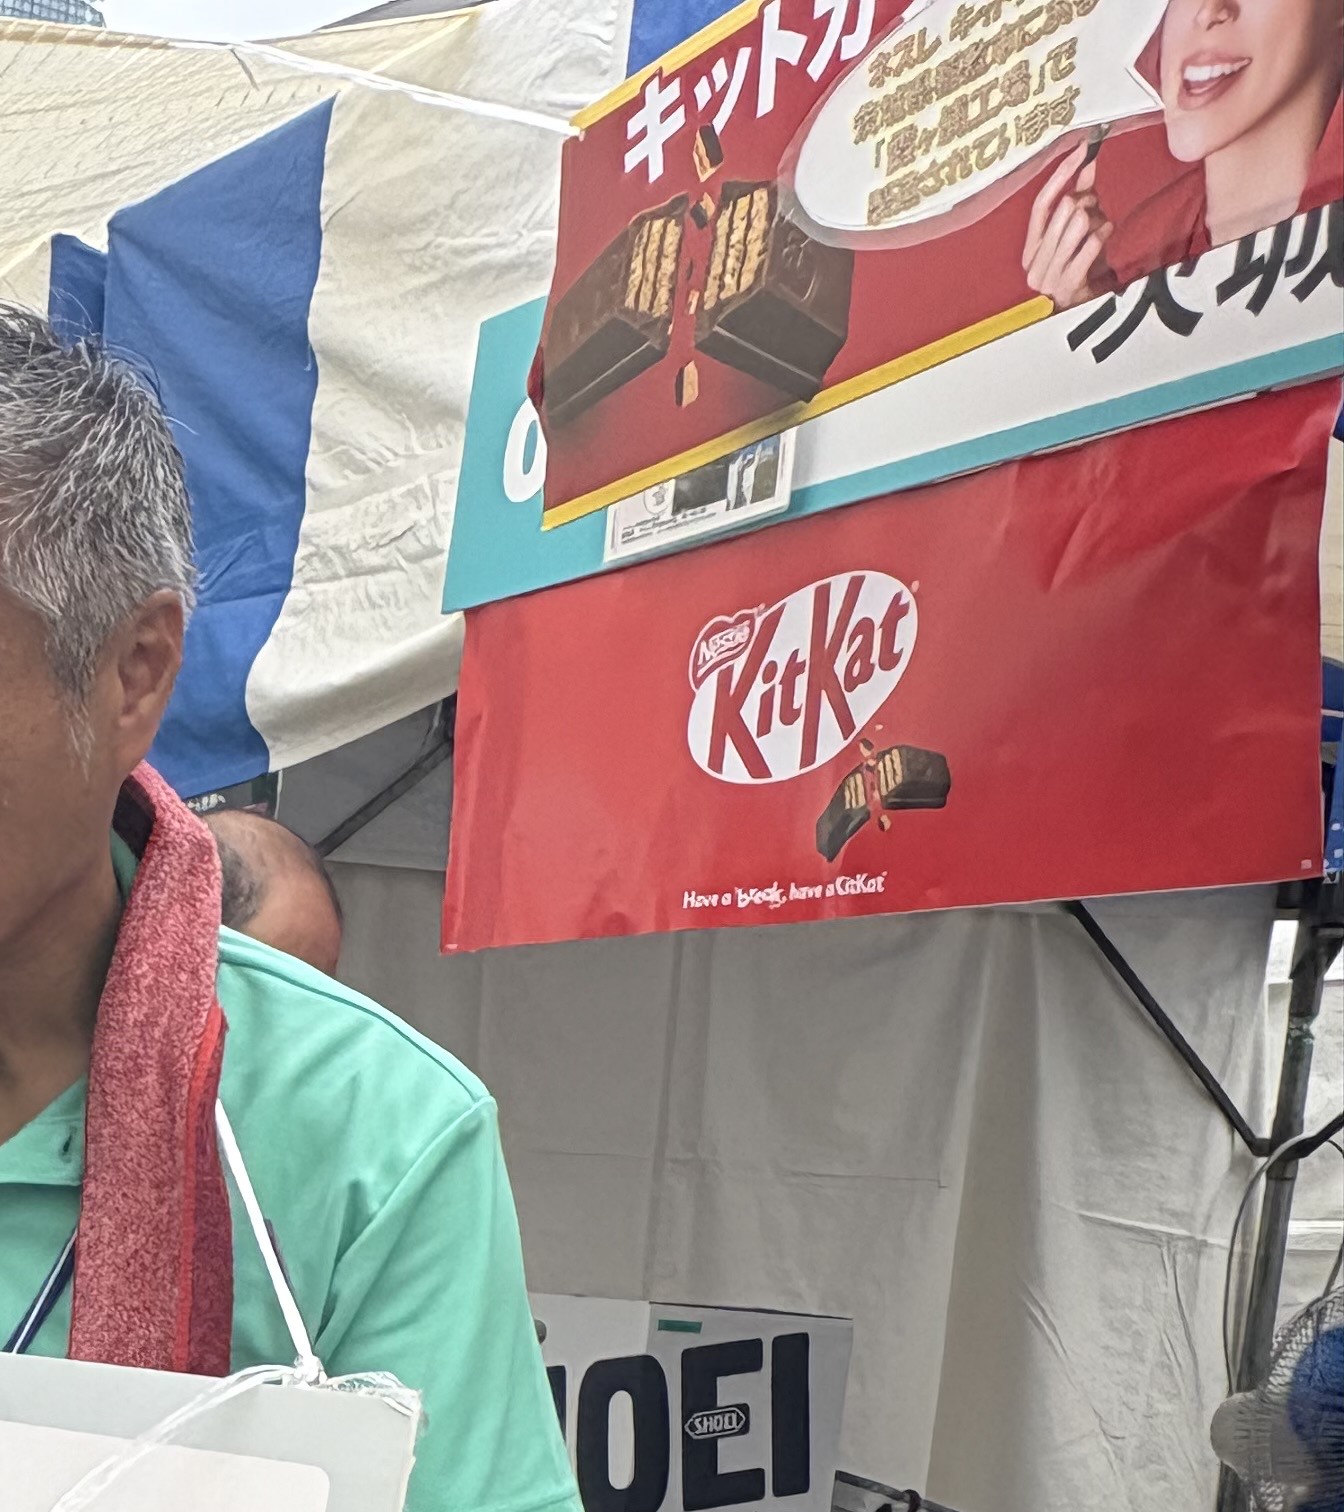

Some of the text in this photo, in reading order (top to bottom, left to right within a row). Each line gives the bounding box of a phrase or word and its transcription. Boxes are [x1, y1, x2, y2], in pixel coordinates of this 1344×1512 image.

[624, 0, 924, 183] キットカ
[708, 575, 911, 779] KitKat
[682, 890, 719, 909] Have
[721, 889, 732, 906] a
[790, 881, 822, 900] have
